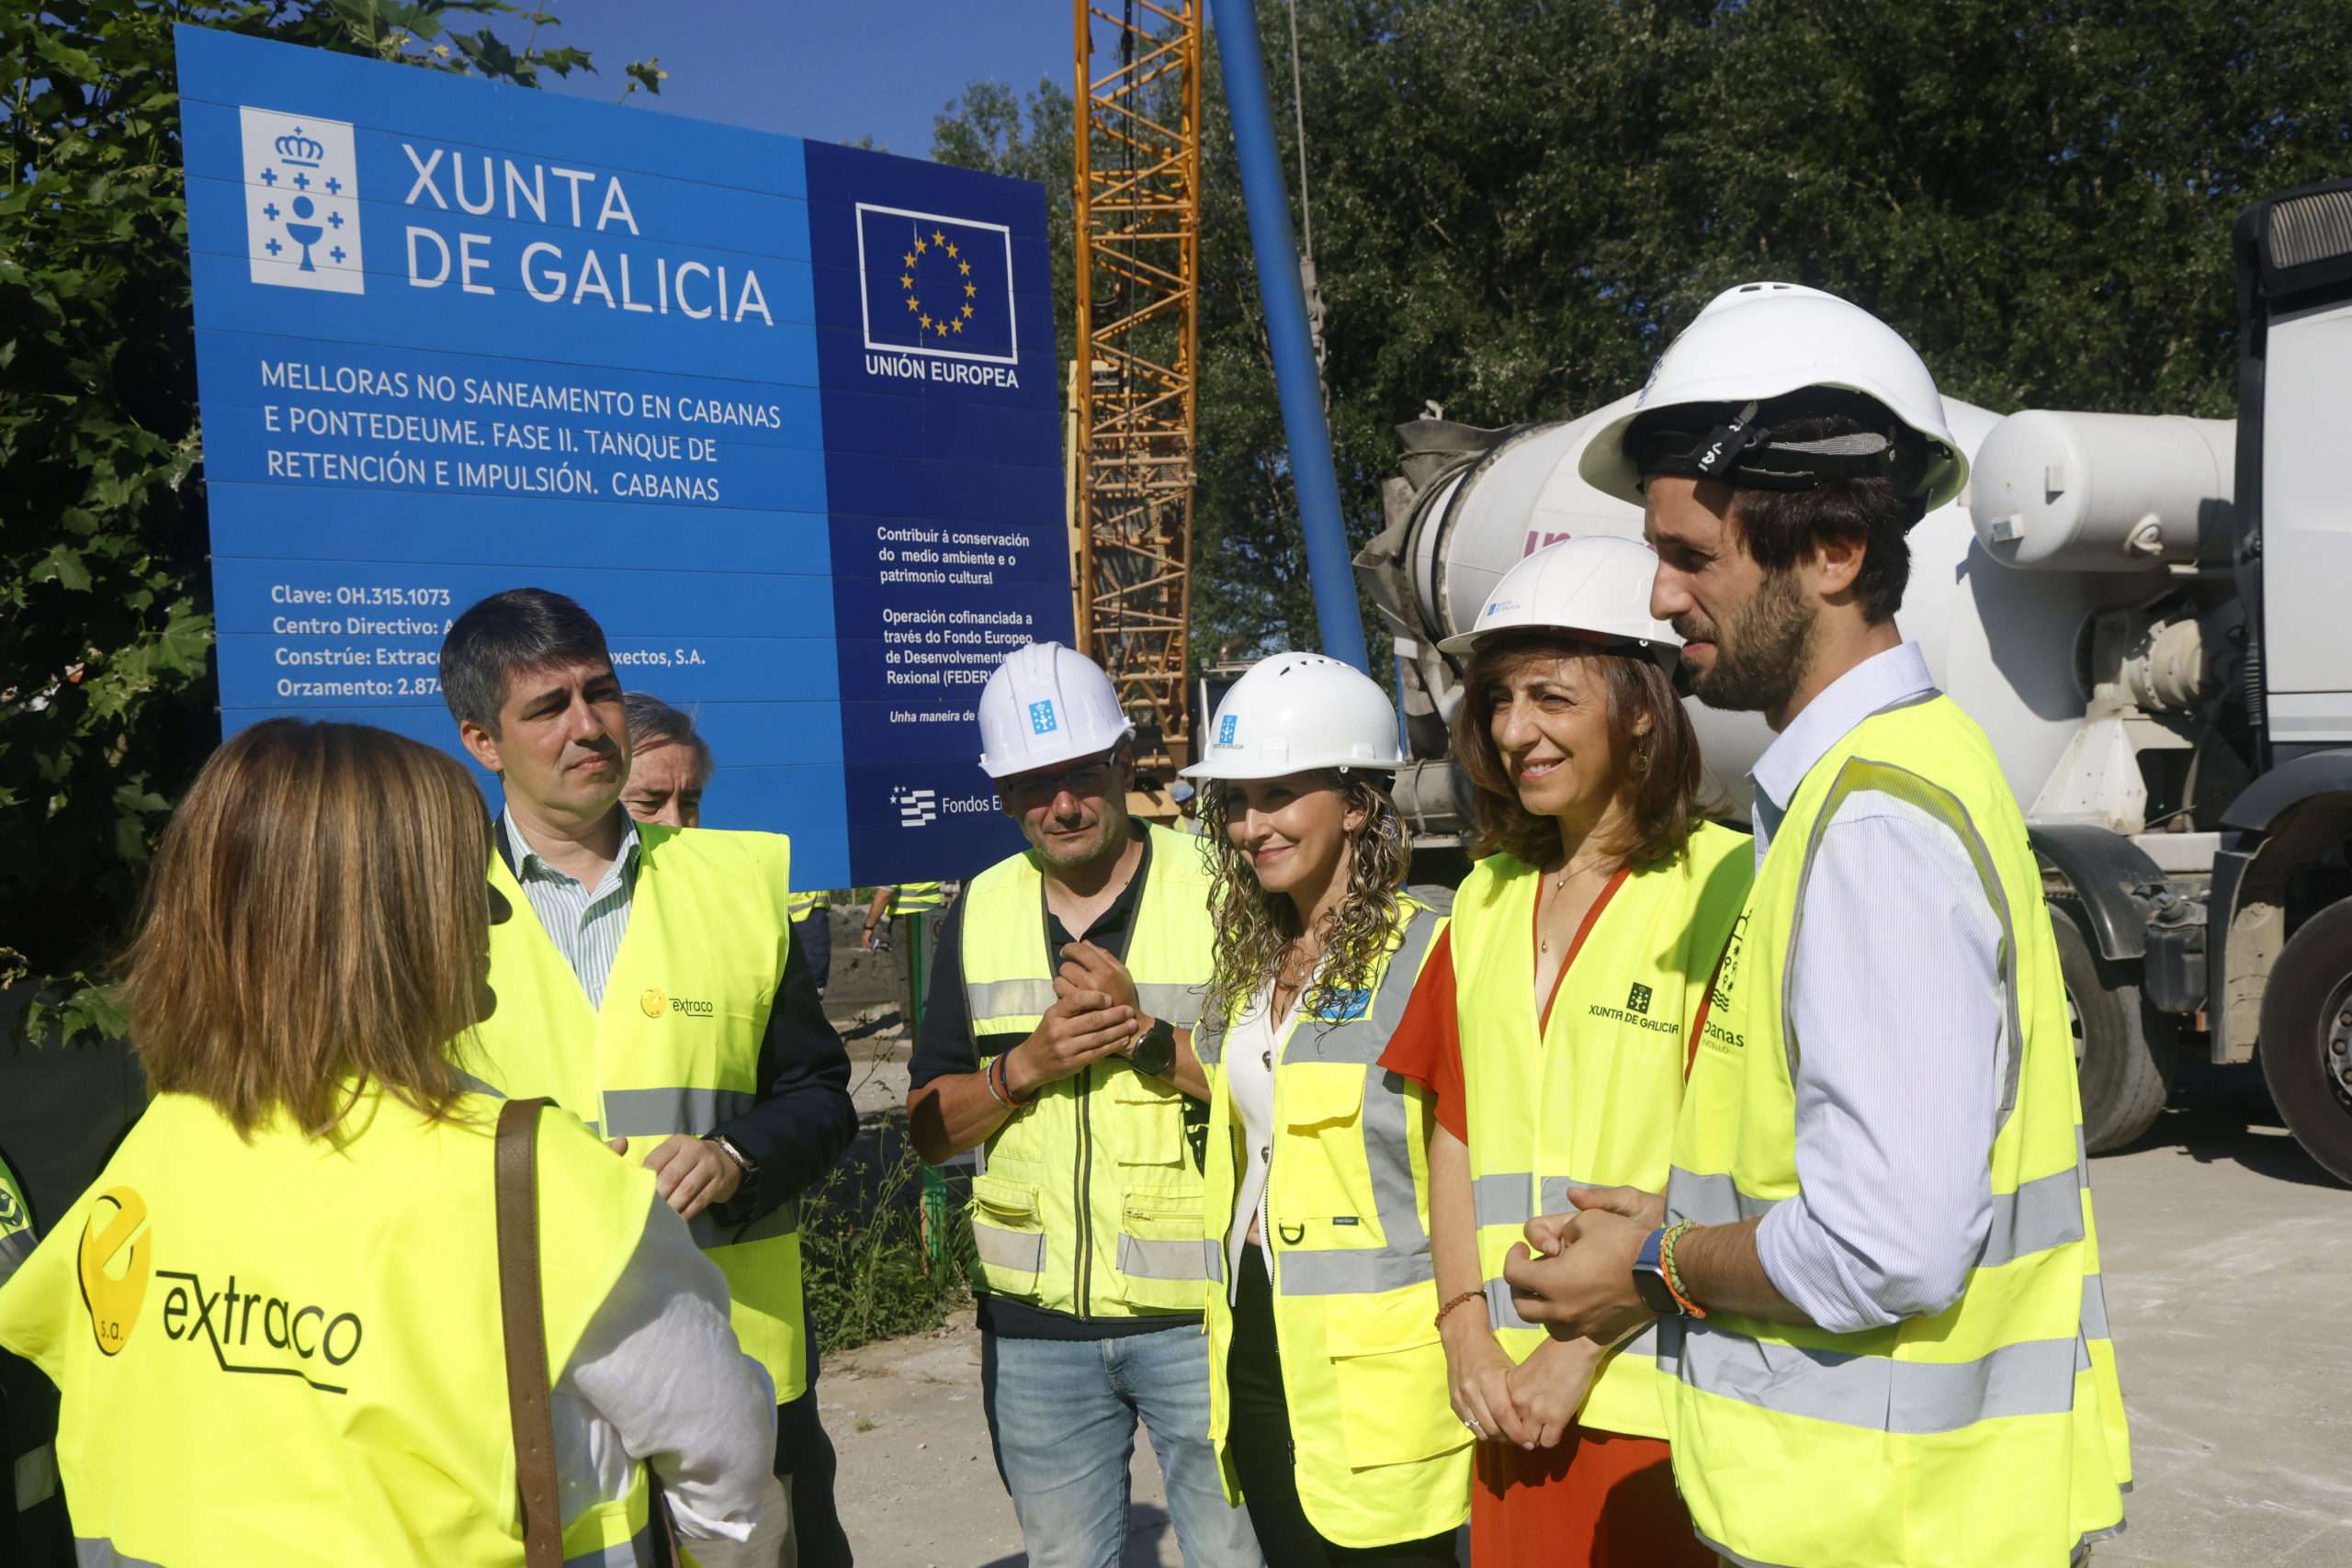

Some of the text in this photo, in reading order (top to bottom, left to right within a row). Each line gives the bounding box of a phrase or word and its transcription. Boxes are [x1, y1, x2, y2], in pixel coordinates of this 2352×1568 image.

[401, 143, 639, 236] XUNTA
[405, 226, 775, 326] DE GALICIA
[865, 353, 1020, 389] UNIÓN EUROPEA
[262, 361, 781, 429] MELLORAS NO SANEAMENTO EN CABANAS
[264, 406, 718, 462] E PONTEDEUME. FASE II. TANQUE DE
[267, 449, 720, 502] RETENCIÓN E IMPULSIÓN. CABANAS
[943, 530, 949, 543] á
[953, 533, 1030, 547] conservación
[878, 547, 1016, 566] do medio ambiente e o
[880, 569, 992, 584] patrimonio cultural
[271, 584, 451, 606] Clave: OH.315.1073
[272, 616, 341, 635] Centro
[347, 617, 438, 636] Directivo:
[883, 609, 1033, 626] Operación cofinanciada a
[884, 630, 1034, 648] través do Fondo Europeo
[275, 647, 371, 666] Constrúe:
[675, 649, 706, 665] S.A.
[886, 650, 900, 663] de
[887, 671, 940, 684] Rexional
[277, 679, 392, 697] Orzamento:
[889, 710, 975, 722] Unha maneira de
[943, 795, 989, 814] Fondos
[671, 998, 713, 1014] extraco
[1588, 1004, 1679, 1034] XUNTA DE GALICIA
[100, 1320, 123, 1341] s.a.
[159, 1271, 364, 1378] extraco
